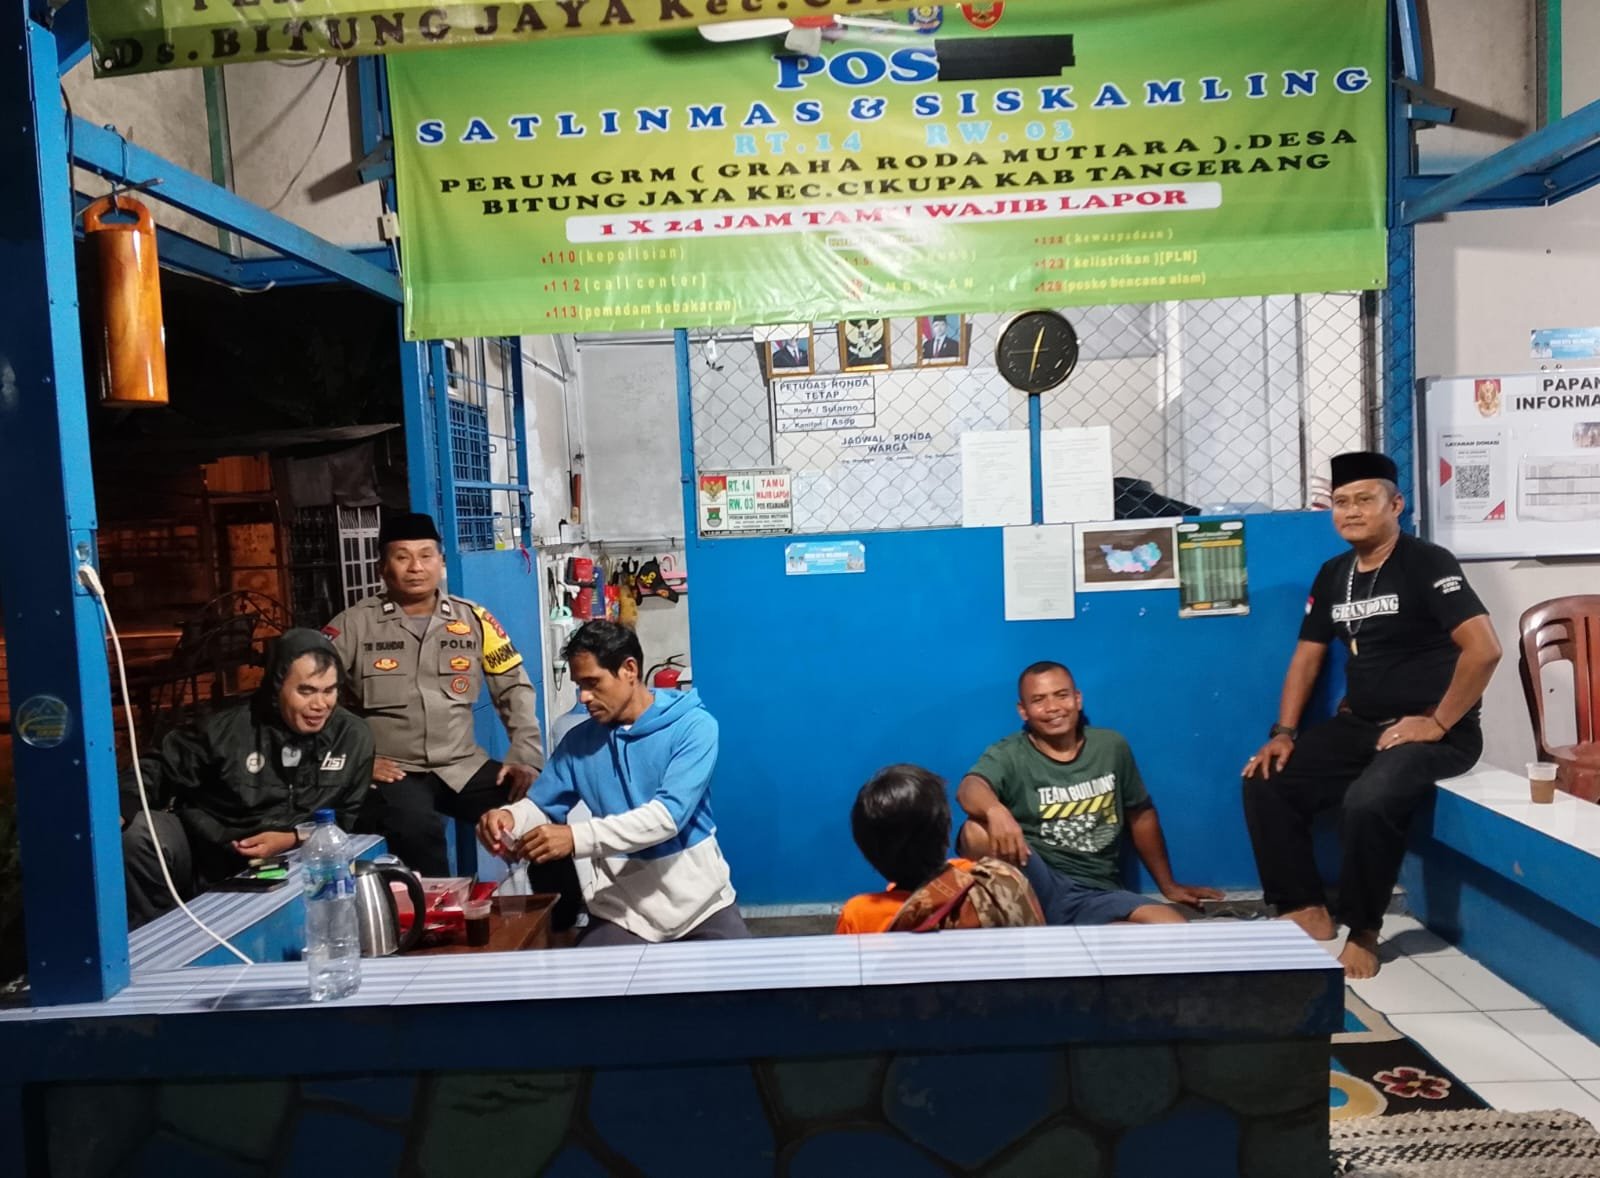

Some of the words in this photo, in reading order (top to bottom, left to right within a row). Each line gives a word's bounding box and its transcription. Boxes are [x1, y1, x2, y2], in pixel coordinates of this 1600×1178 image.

[474, 0, 635, 35] JAYA
[774, 47, 940, 89] POS
[417, 101, 823, 144] SATLINMAS
[850, 97, 886, 121] &
[913, 67, 1371, 117] SISKAMLING
[440, 172, 577, 193] PERUM
[590, 166, 676, 186] GRM
[717, 157, 862, 178] GRAHA
[876, 151, 989, 170] RODA
[1002, 137, 1201, 163] MUTIARA
[482, 193, 627, 216] BITUNG
[638, 186, 736, 207] JAYA
[995, 168, 1075, 188] KAB
[1086, 153, 1331, 182] TANGERANG
[665, 218, 705, 232] 24
[714, 212, 793, 230] JAM
[923, 198, 1048, 218] WAJIB
[1059, 189, 1188, 211] LAPOR
[831, 378, 870, 389] RONDA
[805, 390, 840, 400] TETAP
[841, 435, 886, 446] JADWAL
[894, 432, 932, 442] RONDA
[868, 443, 908, 453] WARGA
[761, 478, 785, 488] TAMU
[440, 640, 477, 650] POLRI
[1038, 786, 1070, 805] TEAM
